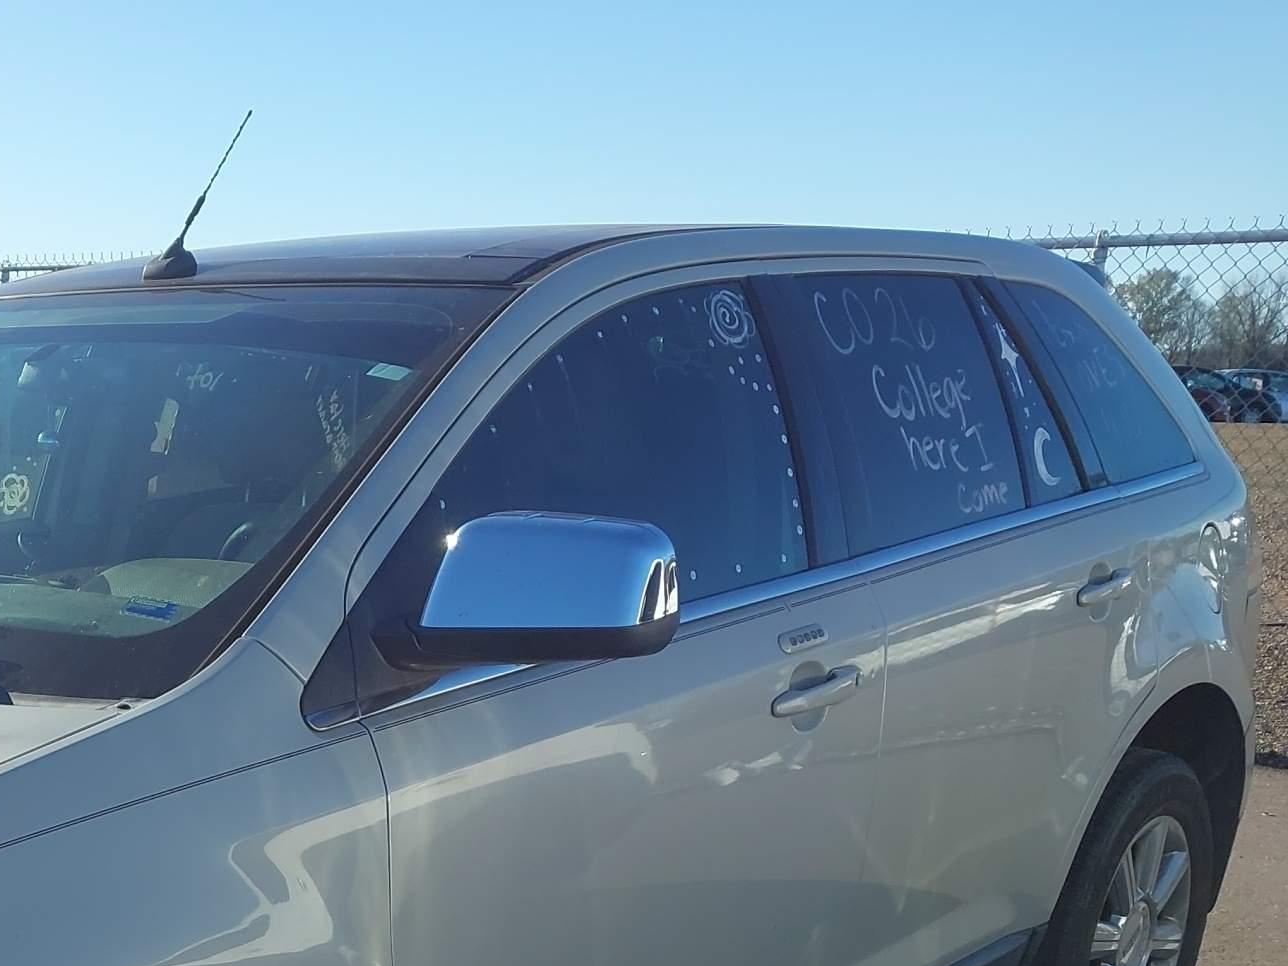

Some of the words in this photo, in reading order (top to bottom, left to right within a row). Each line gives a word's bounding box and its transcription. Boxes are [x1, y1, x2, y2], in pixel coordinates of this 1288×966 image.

[872, 364, 972, 431] College
[900, 426, 969, 472] here
[964, 422, 993, 472] I
